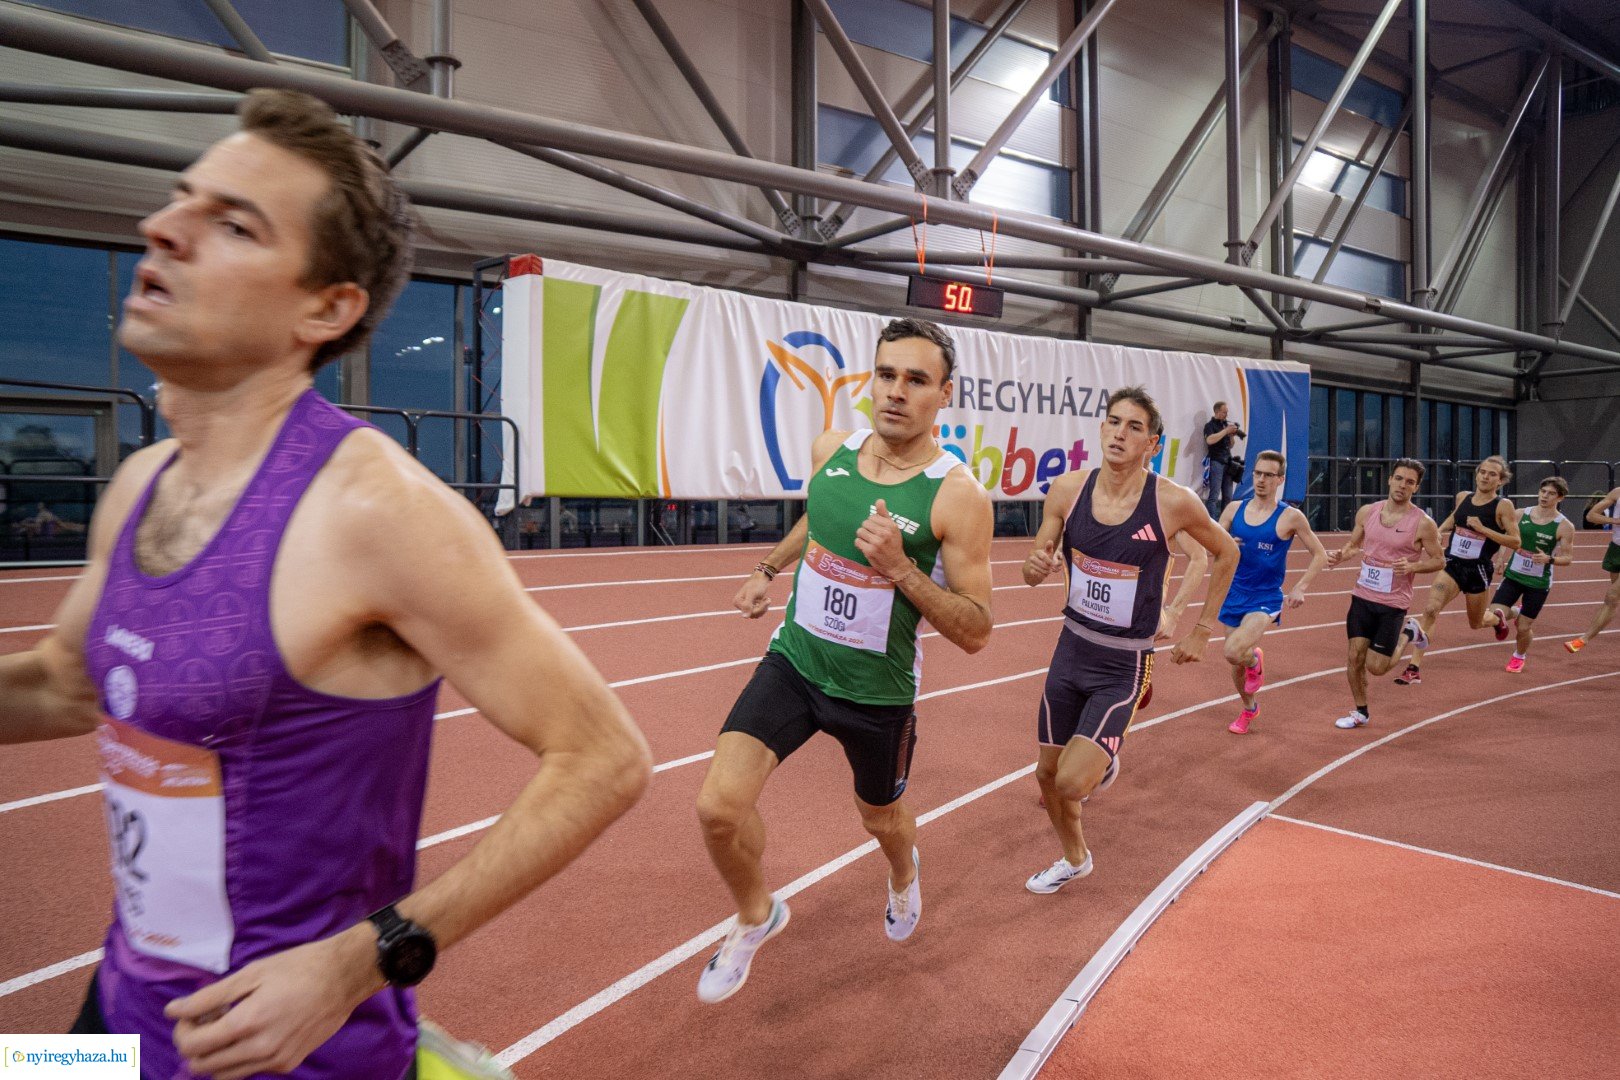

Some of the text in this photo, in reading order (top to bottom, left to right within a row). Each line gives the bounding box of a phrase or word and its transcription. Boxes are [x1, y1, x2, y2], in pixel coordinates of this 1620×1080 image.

[931, 423, 1089, 497] öbbet
[1258, 541, 1273, 551] KSI
[1367, 568, 1380, 581] 152
[823, 585, 858, 621] 180
[1086, 579, 1112, 604] 166
